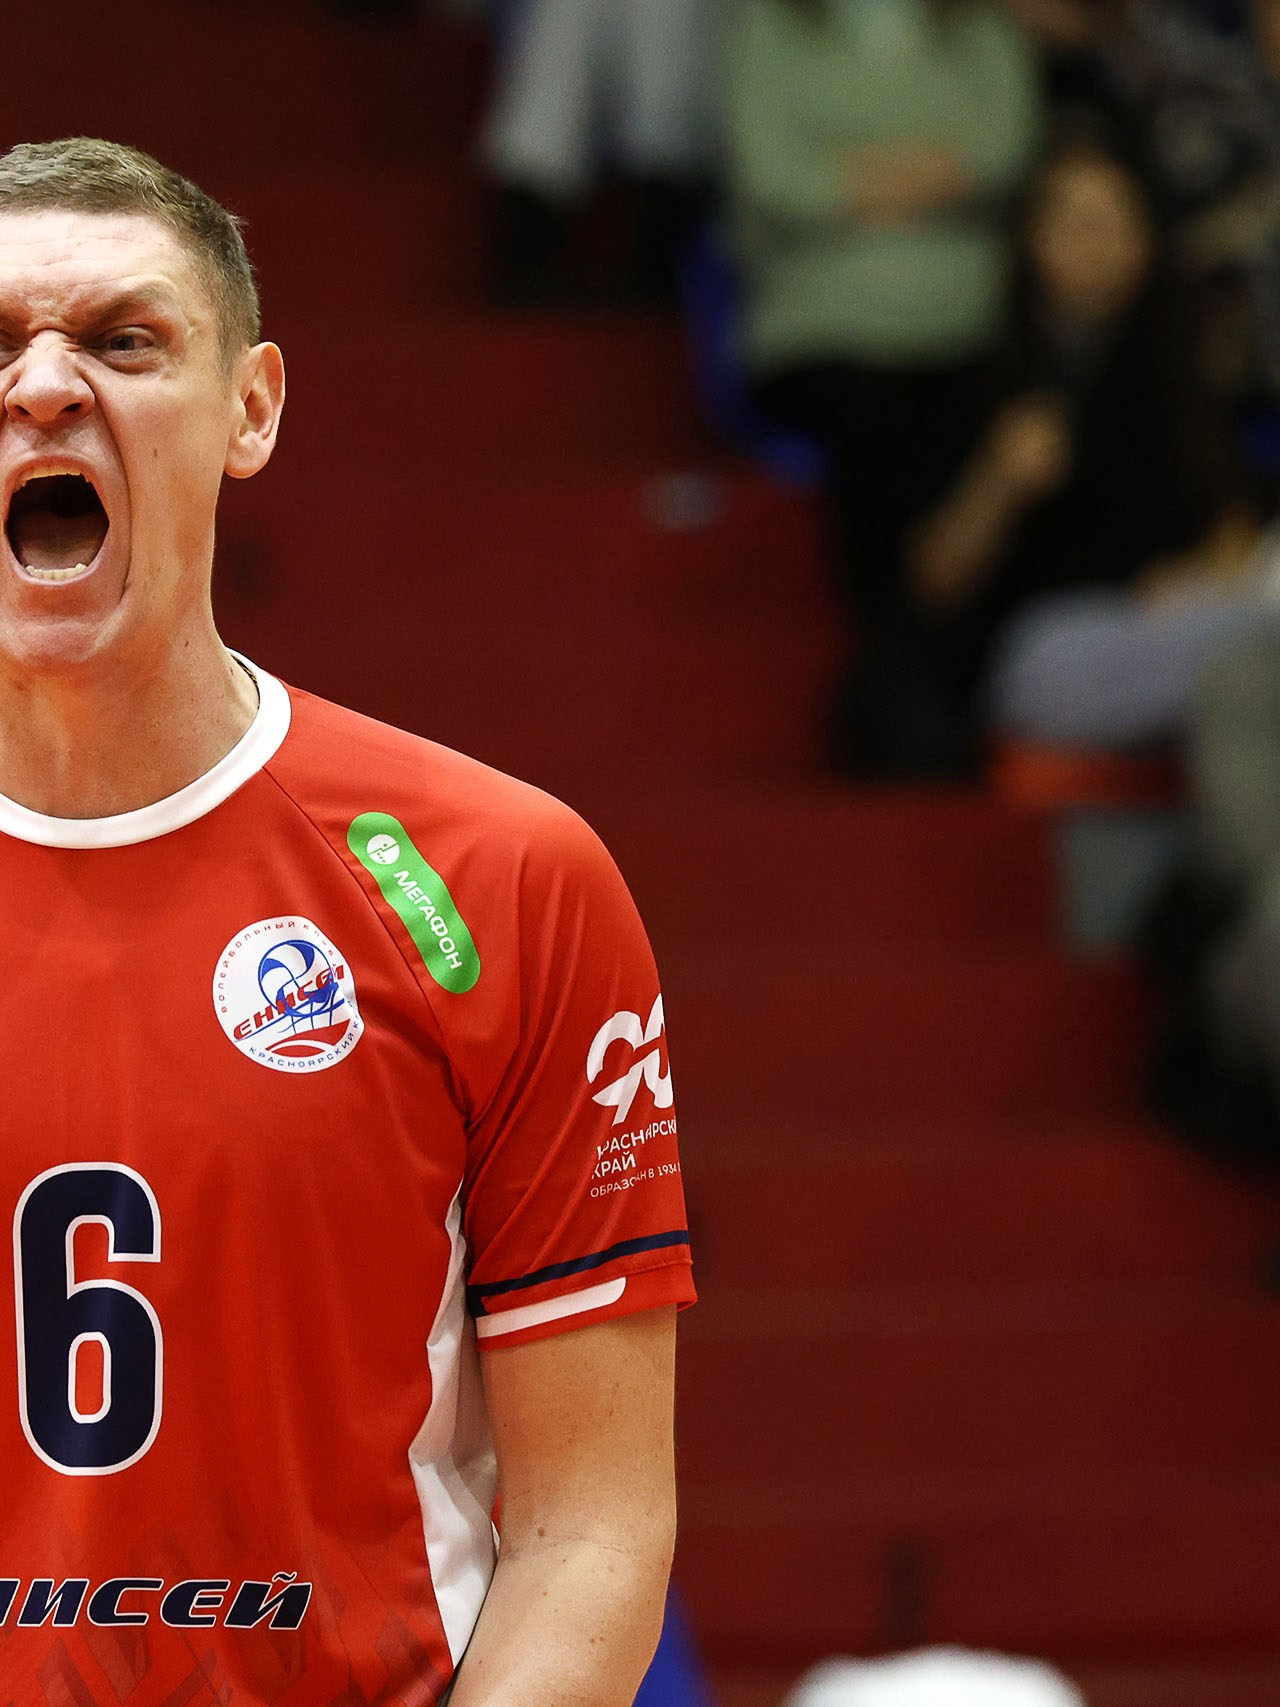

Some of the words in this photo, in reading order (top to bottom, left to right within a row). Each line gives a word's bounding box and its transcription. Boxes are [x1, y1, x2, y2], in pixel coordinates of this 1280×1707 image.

[393, 870, 463, 970] МЕГАФОН
[248, 1032, 355, 1068] КРАСНОЯРСКИЙ
[13, 1162, 163, 1476] 6
